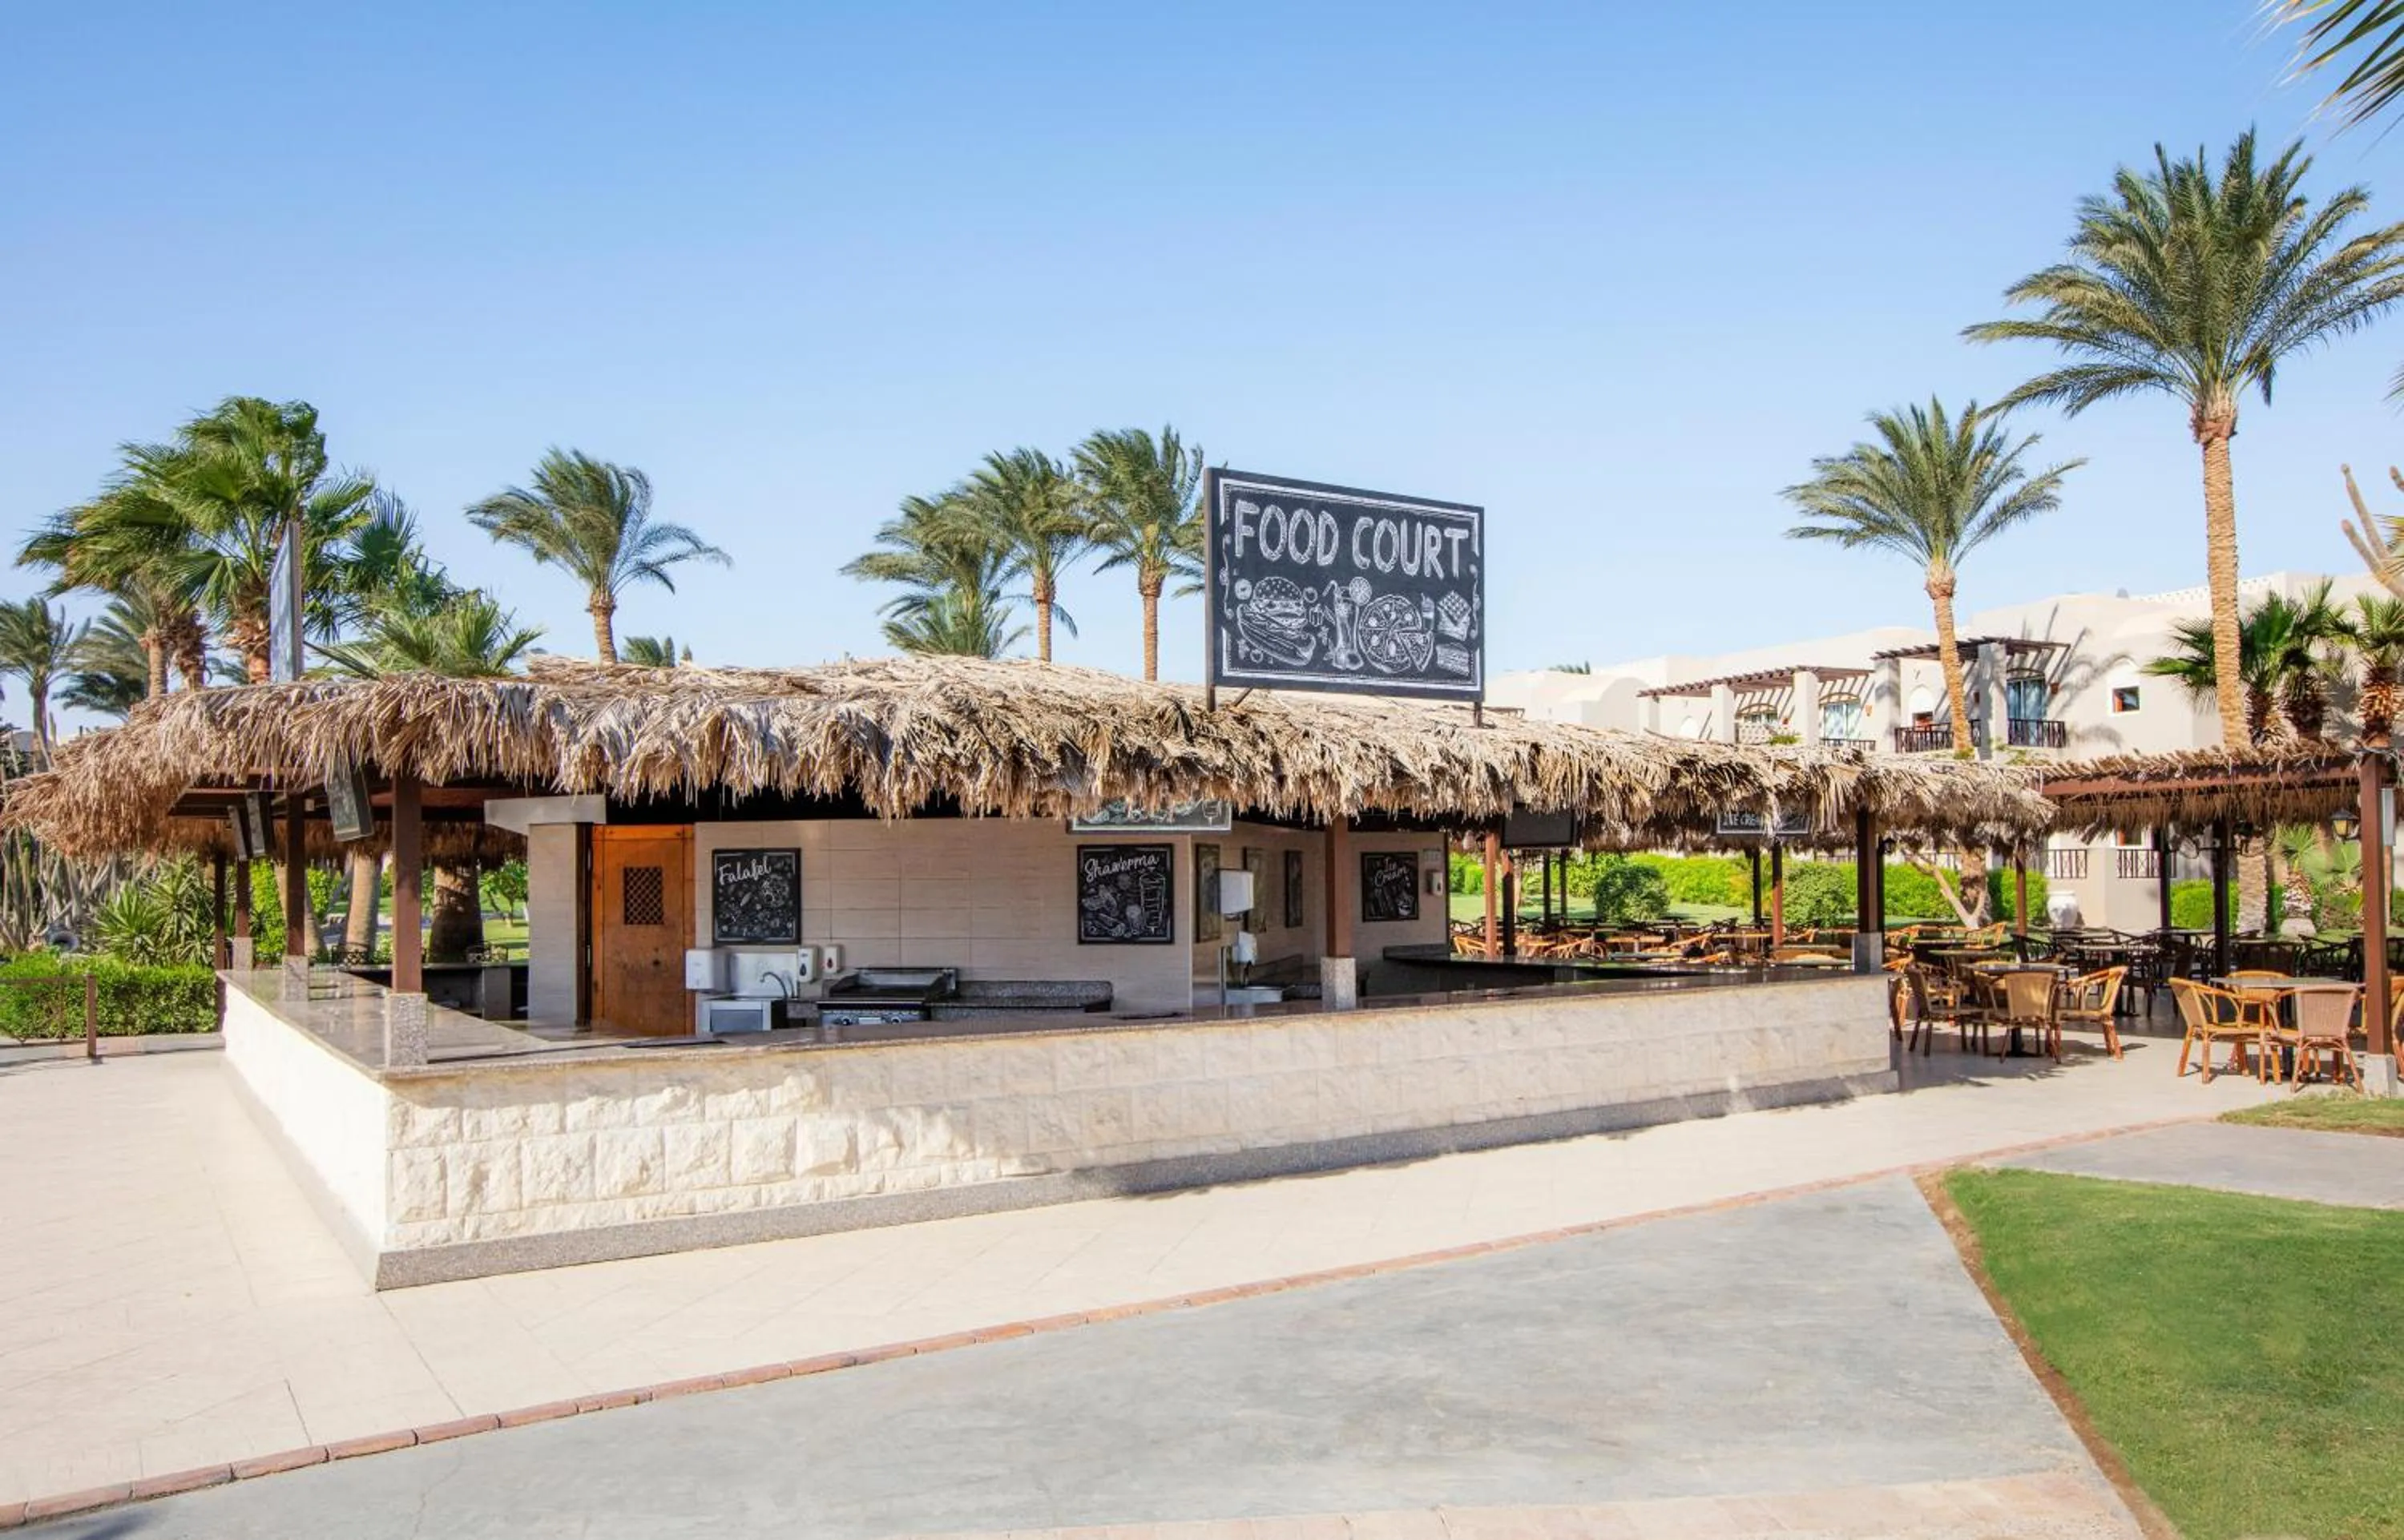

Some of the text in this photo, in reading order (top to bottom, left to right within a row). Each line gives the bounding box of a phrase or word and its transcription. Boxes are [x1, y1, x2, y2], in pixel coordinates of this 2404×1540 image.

[1234, 499, 1469, 579] FOOD COURT
[718, 856, 770, 885] Falafel
